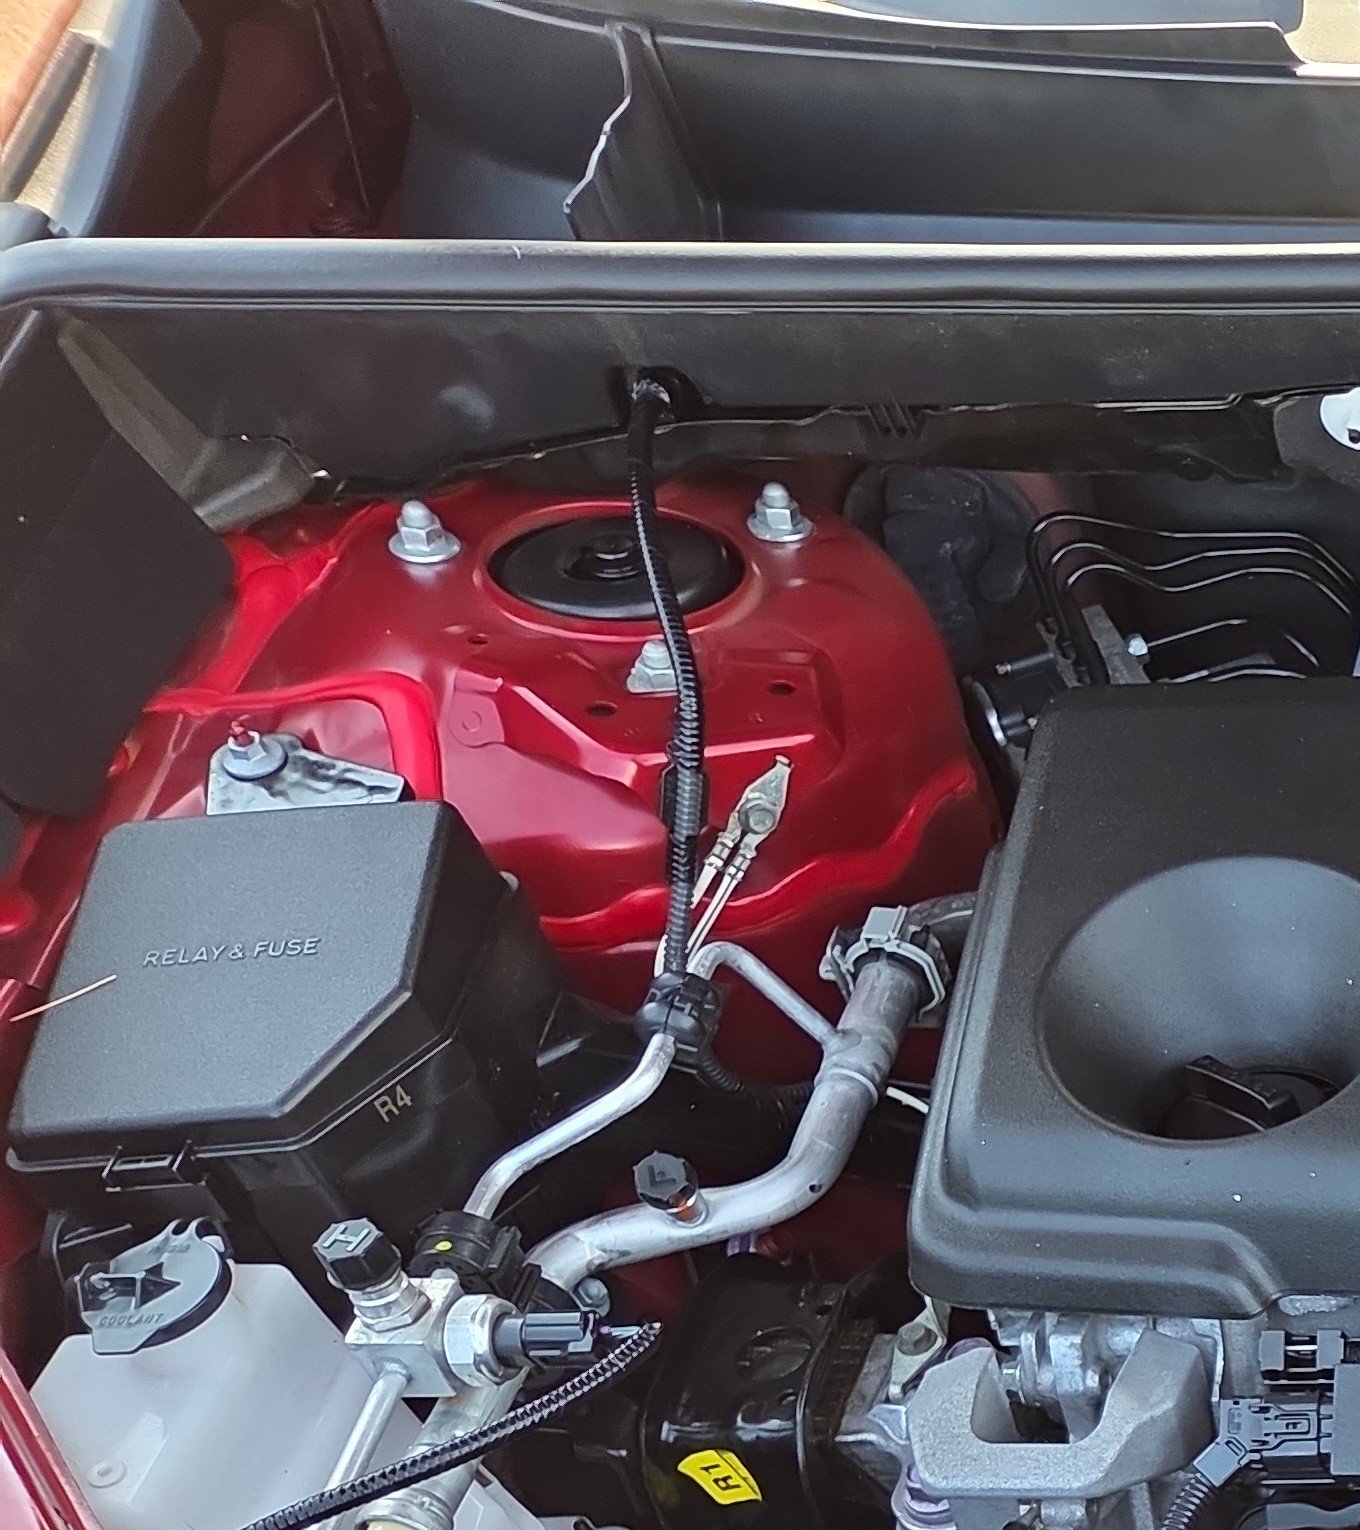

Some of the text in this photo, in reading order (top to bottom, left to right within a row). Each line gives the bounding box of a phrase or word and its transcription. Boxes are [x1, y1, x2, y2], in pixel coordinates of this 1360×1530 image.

[143, 937, 319, 967] RELAY & FUSE
[374, 1086, 412, 1123] R4
[98, 1312, 164, 1327] COOLANT
[699, 1463, 742, 1491] R1
